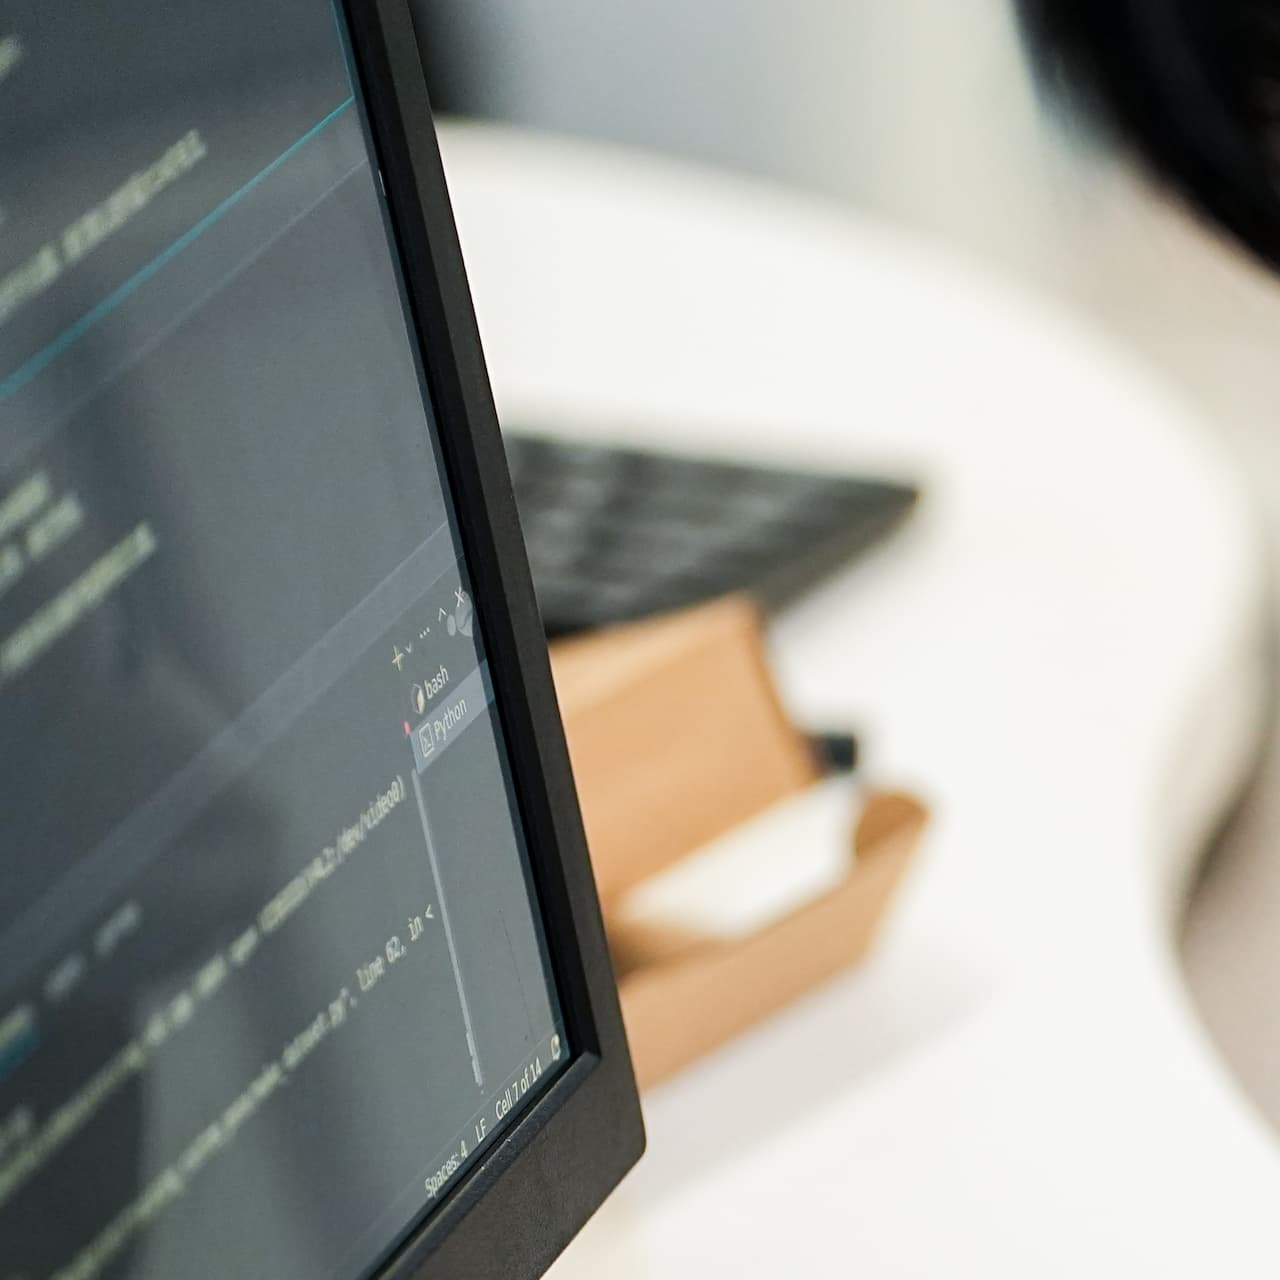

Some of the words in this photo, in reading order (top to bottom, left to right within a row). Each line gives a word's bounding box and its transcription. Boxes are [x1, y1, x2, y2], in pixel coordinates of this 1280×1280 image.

[424, 665, 449, 699] bash
[433, 698, 467, 740] Python
[356, 956, 385, 991] line
[408, 916, 424, 942] in
[425, 1153, 460, 1199] Spaces:
[460, 1140, 468, 1159] 4
[475, 1117, 488, 1143] LF
[495, 1089, 513, 1120] Cell
[512, 1081, 521, 1101] 7
[520, 1068, 530, 1093] of
[530, 1056, 542, 1083] 14
